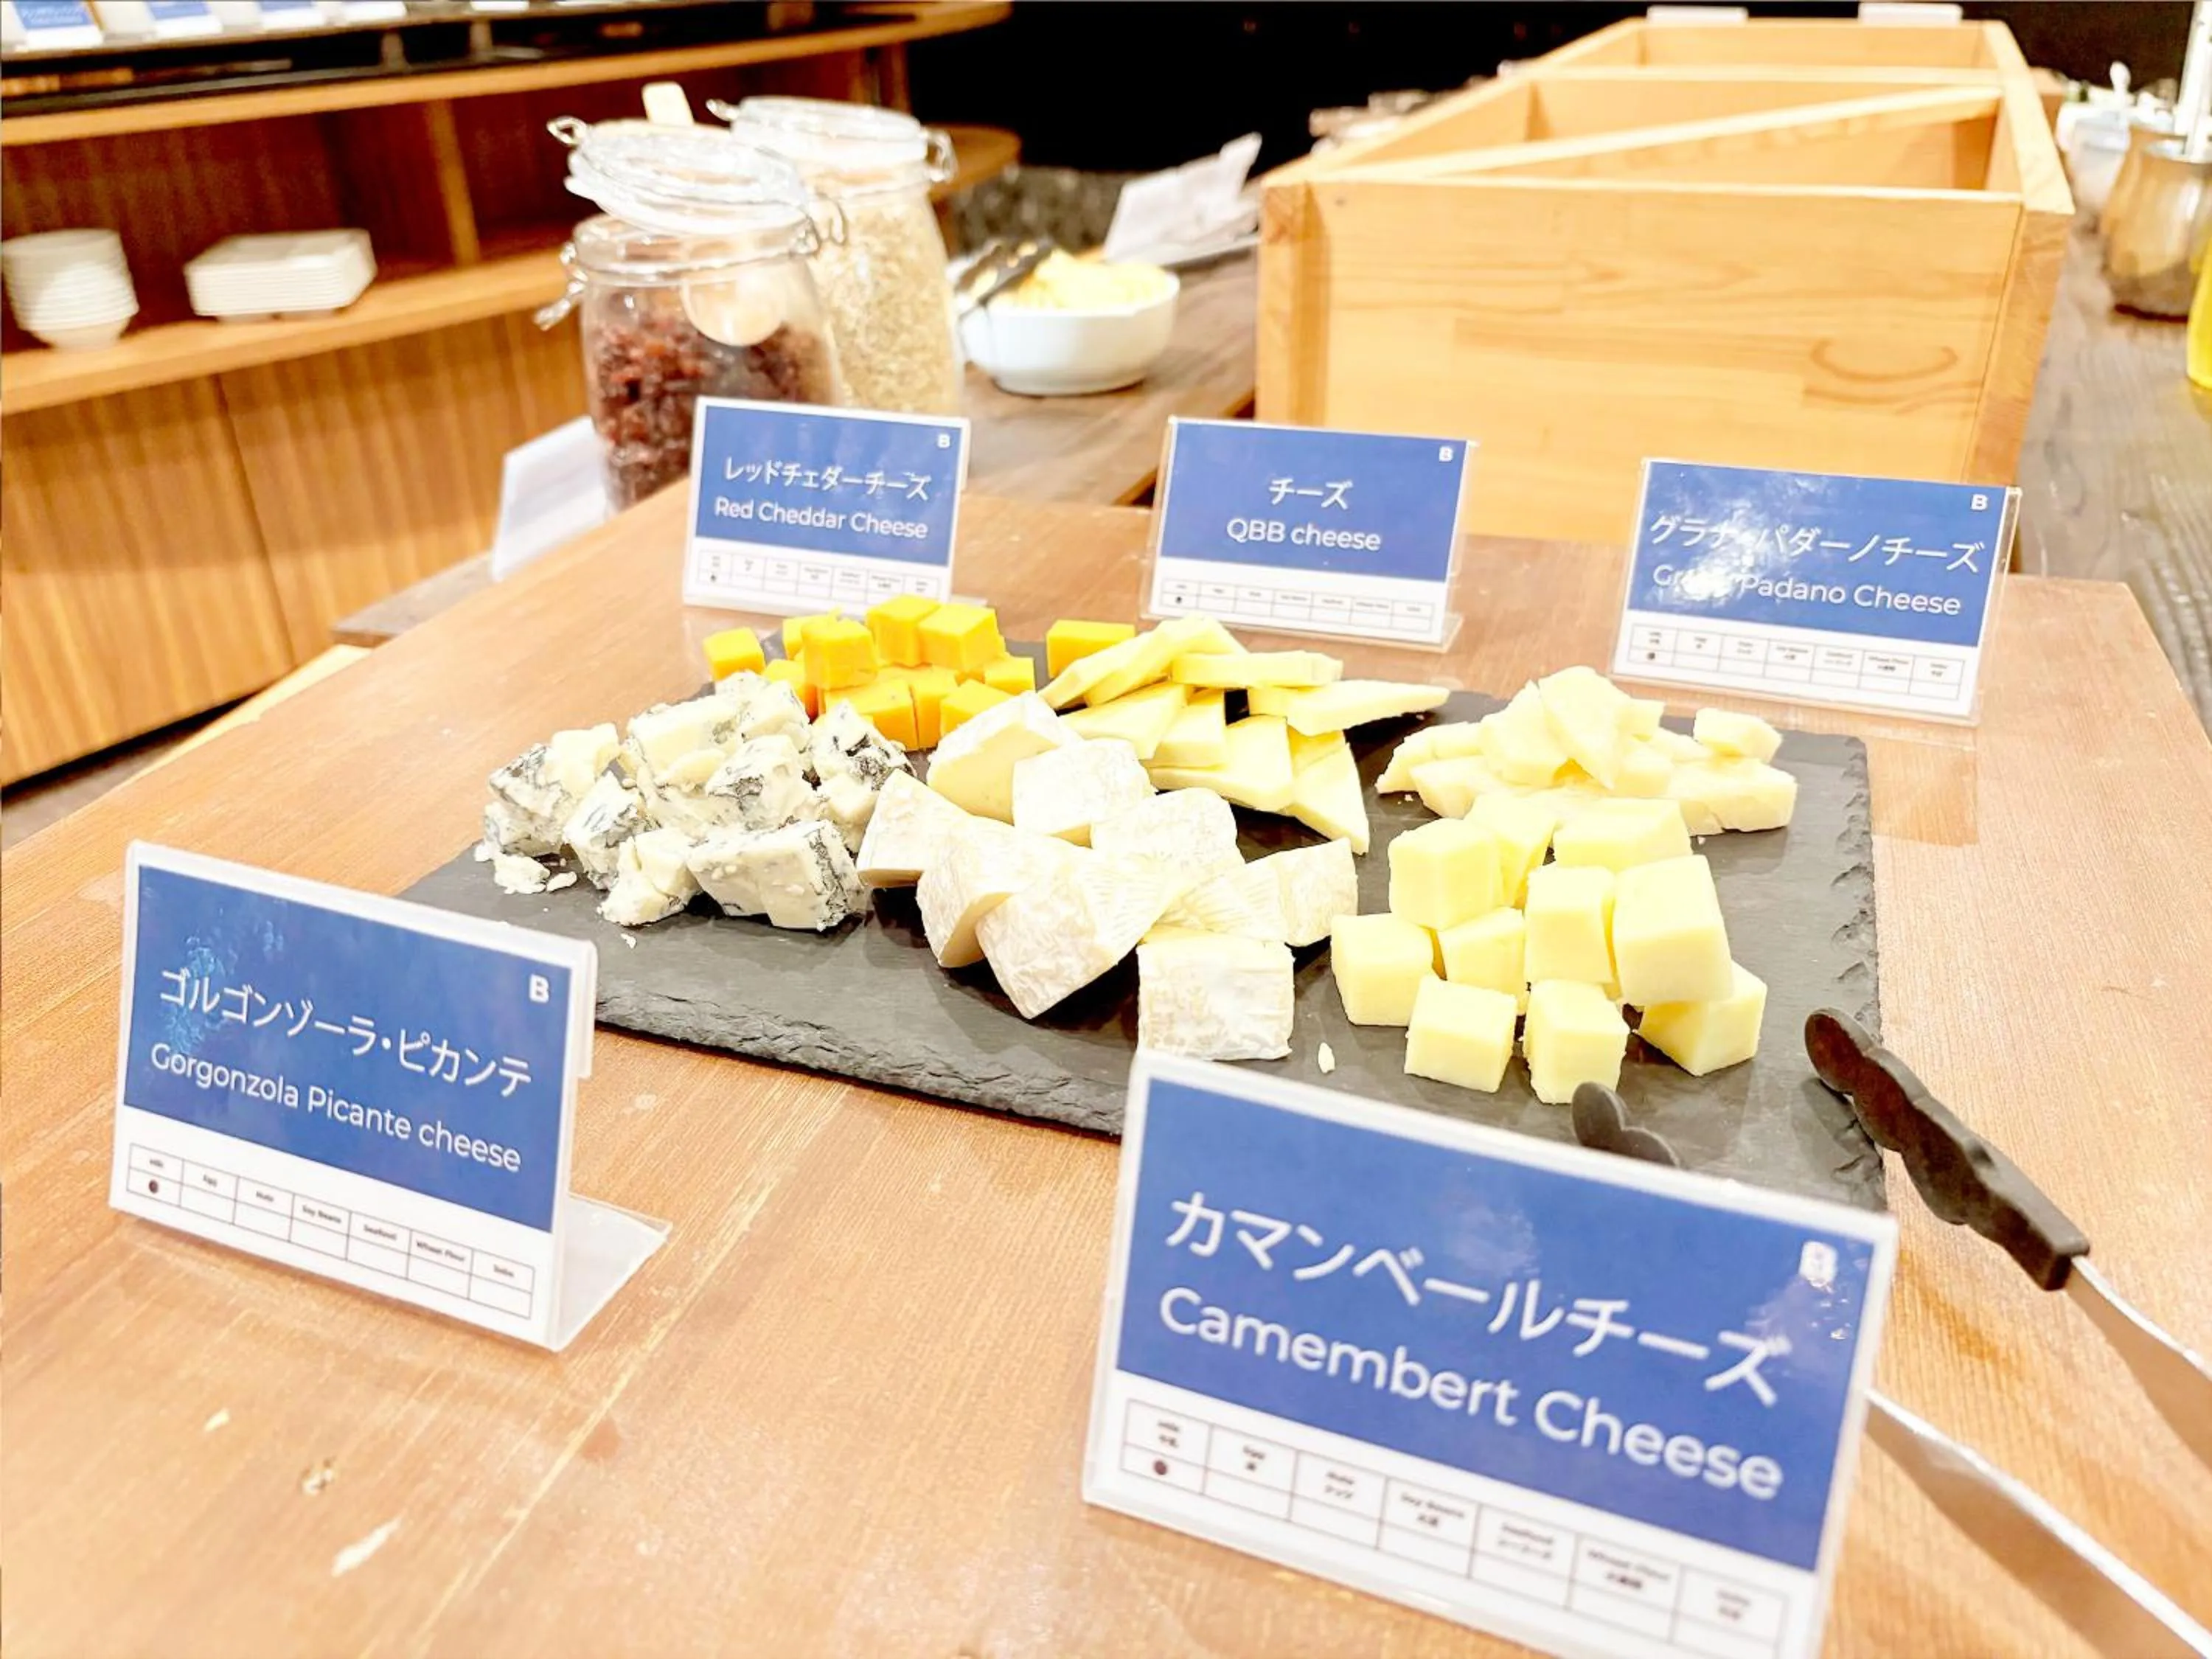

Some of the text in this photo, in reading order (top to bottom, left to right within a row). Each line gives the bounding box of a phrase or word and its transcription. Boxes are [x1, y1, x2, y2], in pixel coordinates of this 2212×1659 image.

[937, 433, 951, 448] B
[1439, 446, 1454, 462] B
[726, 456, 932, 501] レッドチェダーチーズ
[1268, 477, 1353, 510] チーズ
[714, 496, 929, 540] Red Cheddar Cheese
[1970, 493, 1989, 510] B
[1226, 518, 1382, 552] QBB cheese
[1649, 514, 1985, 574] グラナパダーノチーズ
[1738, 573, 1846, 604] Padano
[1854, 584, 1961, 616] Cheese
[529, 973, 551, 1004] B
[160, 966, 532, 1098] ゴルゴンゾーラ・ピカンテ
[150, 1042, 522, 1173] Gorgonzola Picante cheese
[1166, 1191, 1795, 1407] カマンベールチーズ
[1160, 1287, 1784, 1500] Camembert Cheese
